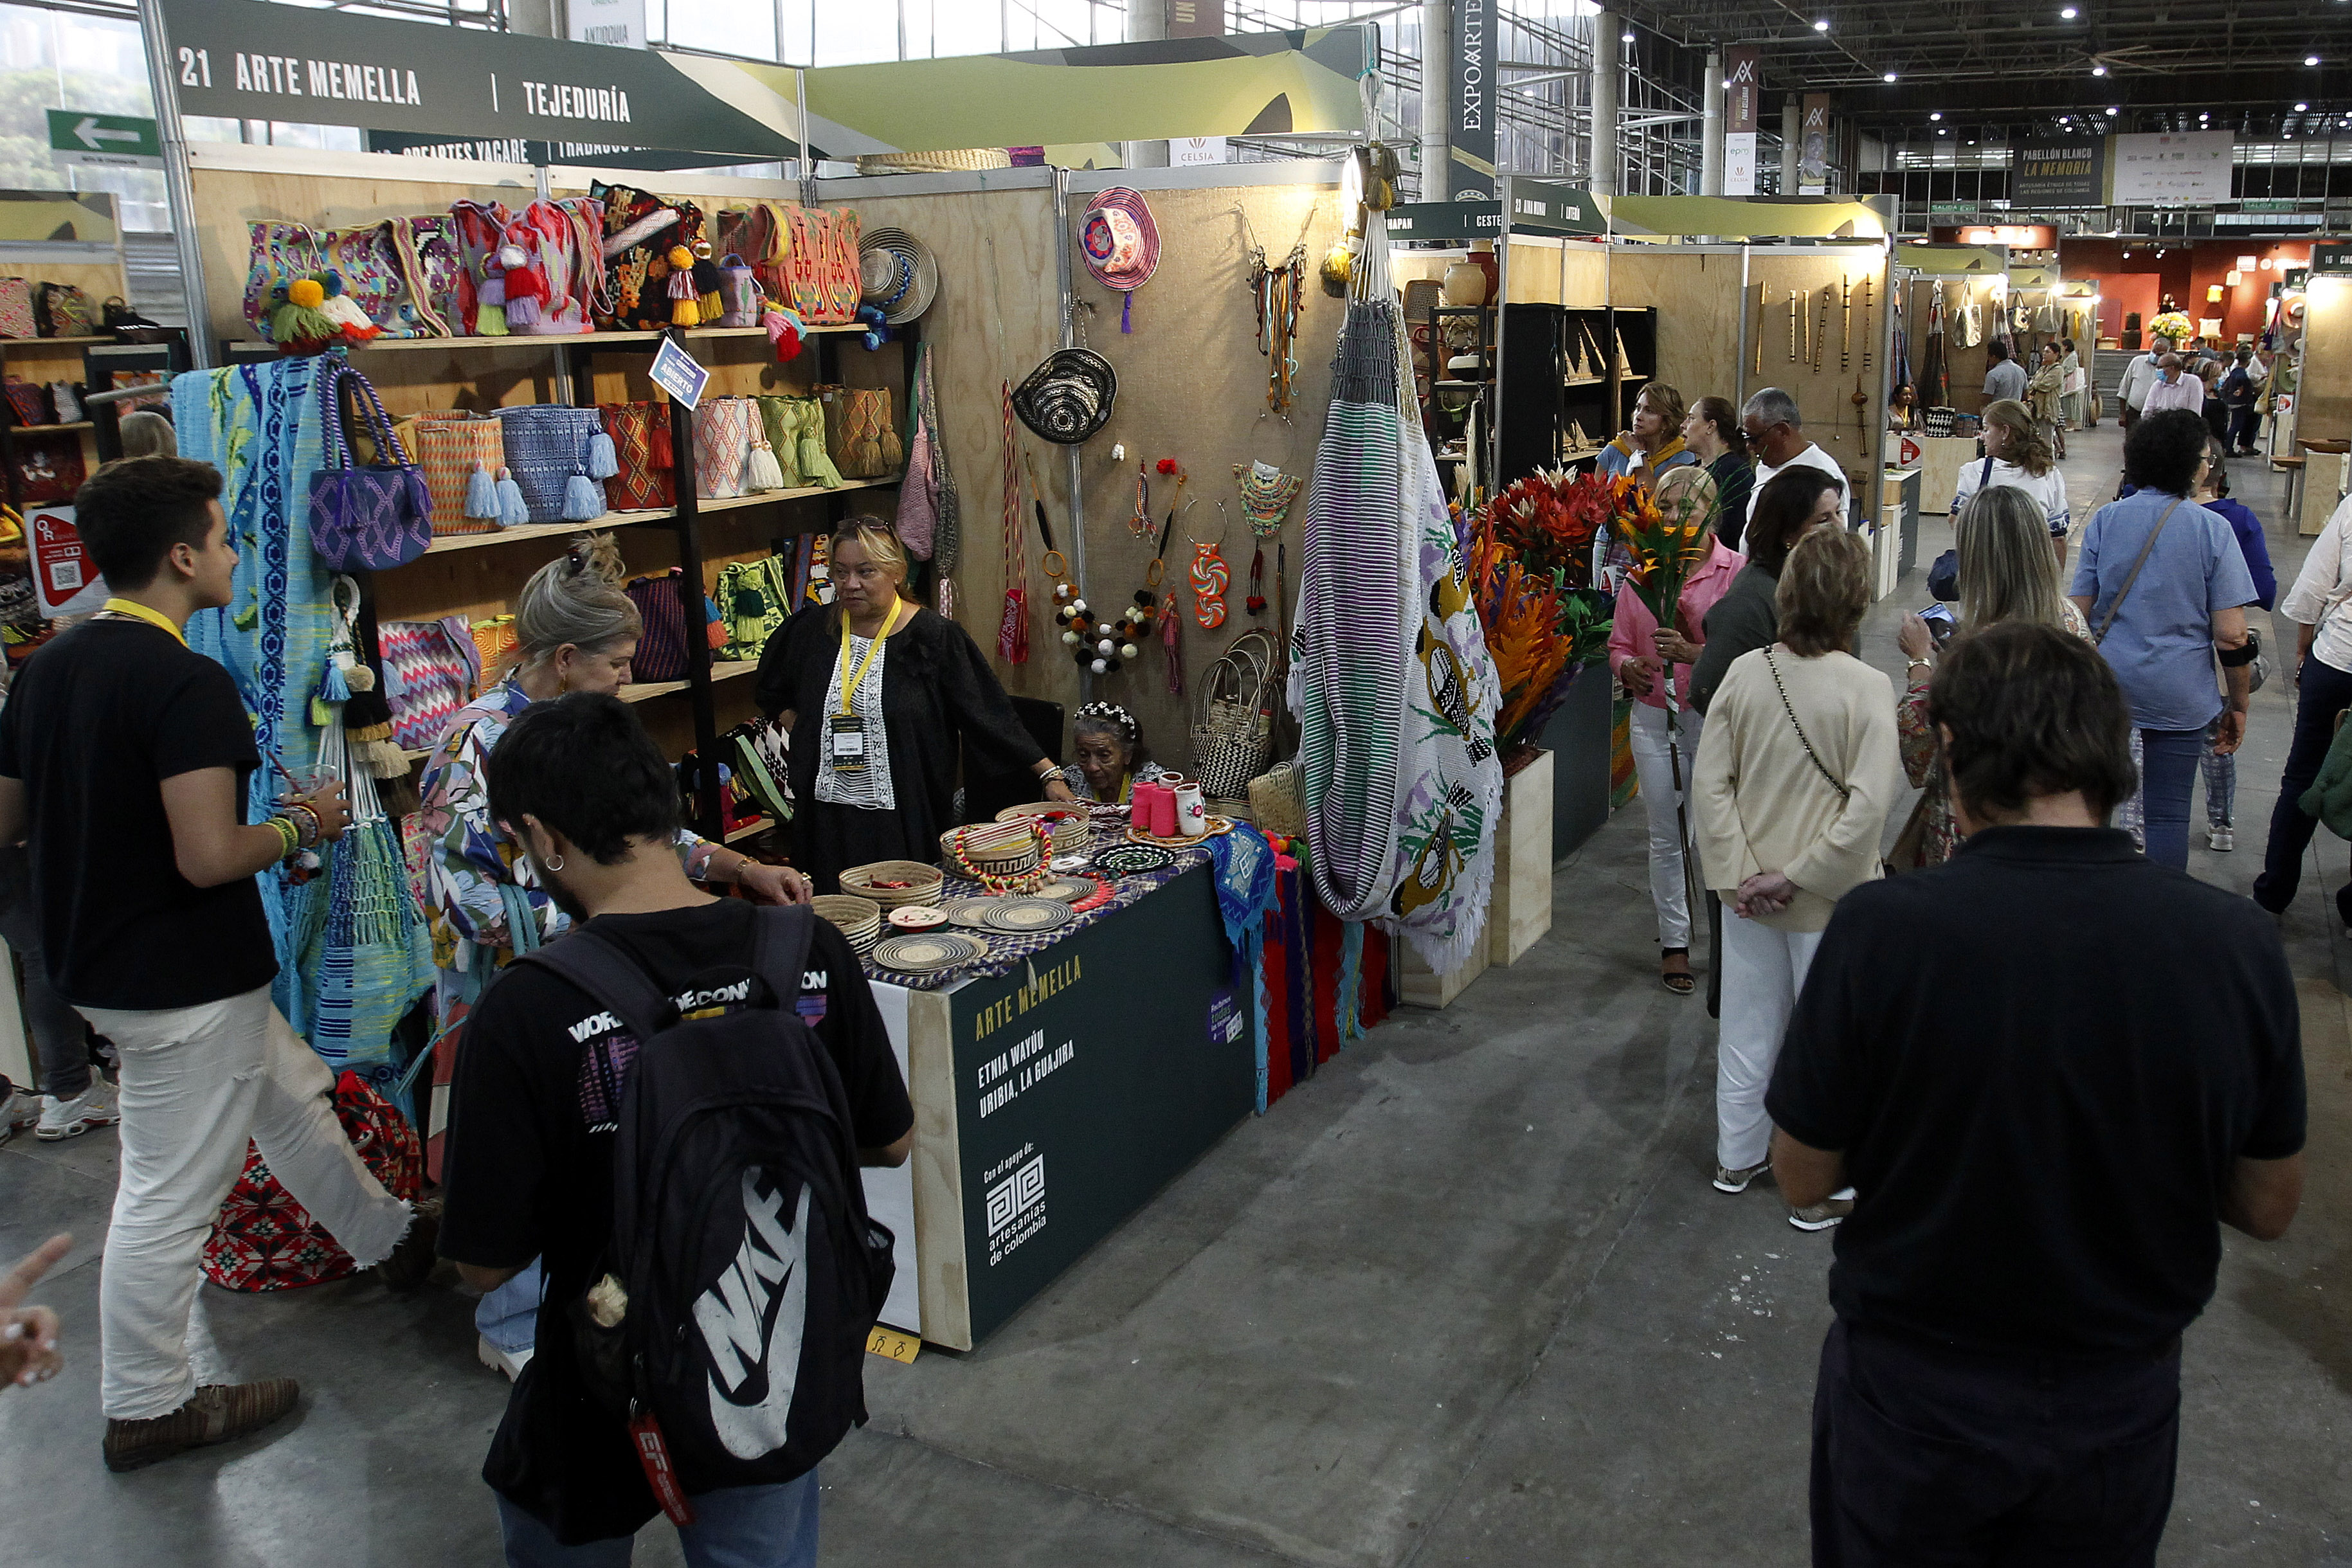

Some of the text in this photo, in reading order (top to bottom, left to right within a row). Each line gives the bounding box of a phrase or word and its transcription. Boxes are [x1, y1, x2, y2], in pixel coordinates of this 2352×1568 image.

[177, 46, 421, 106] 21 ARTE MEMELLA
[522, 81, 631, 123] TEJEDURÍA
[1181, 152, 1214, 161] CELSIA
[1730, 147, 1749, 156] epm
[2023, 147, 2092, 160] PABELLÓN BLANCO
[2023, 161, 2092, 177] LA MEMORIA
[660, 363, 693, 393] ABIERTO
[975, 954, 1081, 1041] ARTE MEMELLA
[1211, 1005, 1231, 1023] todas
[978, 1029, 1044, 1089] ETNIA WAYÚU
[979, 1039, 1074, 1119] URIBIA, LA GUAJIRA
[984, 1142, 1035, 1184] Con el apoyo de:
[989, 1201, 1045, 1252] artesanías
[990, 1216, 1047, 1266] de colombia
[692, 1166, 796, 1393] NIKE
